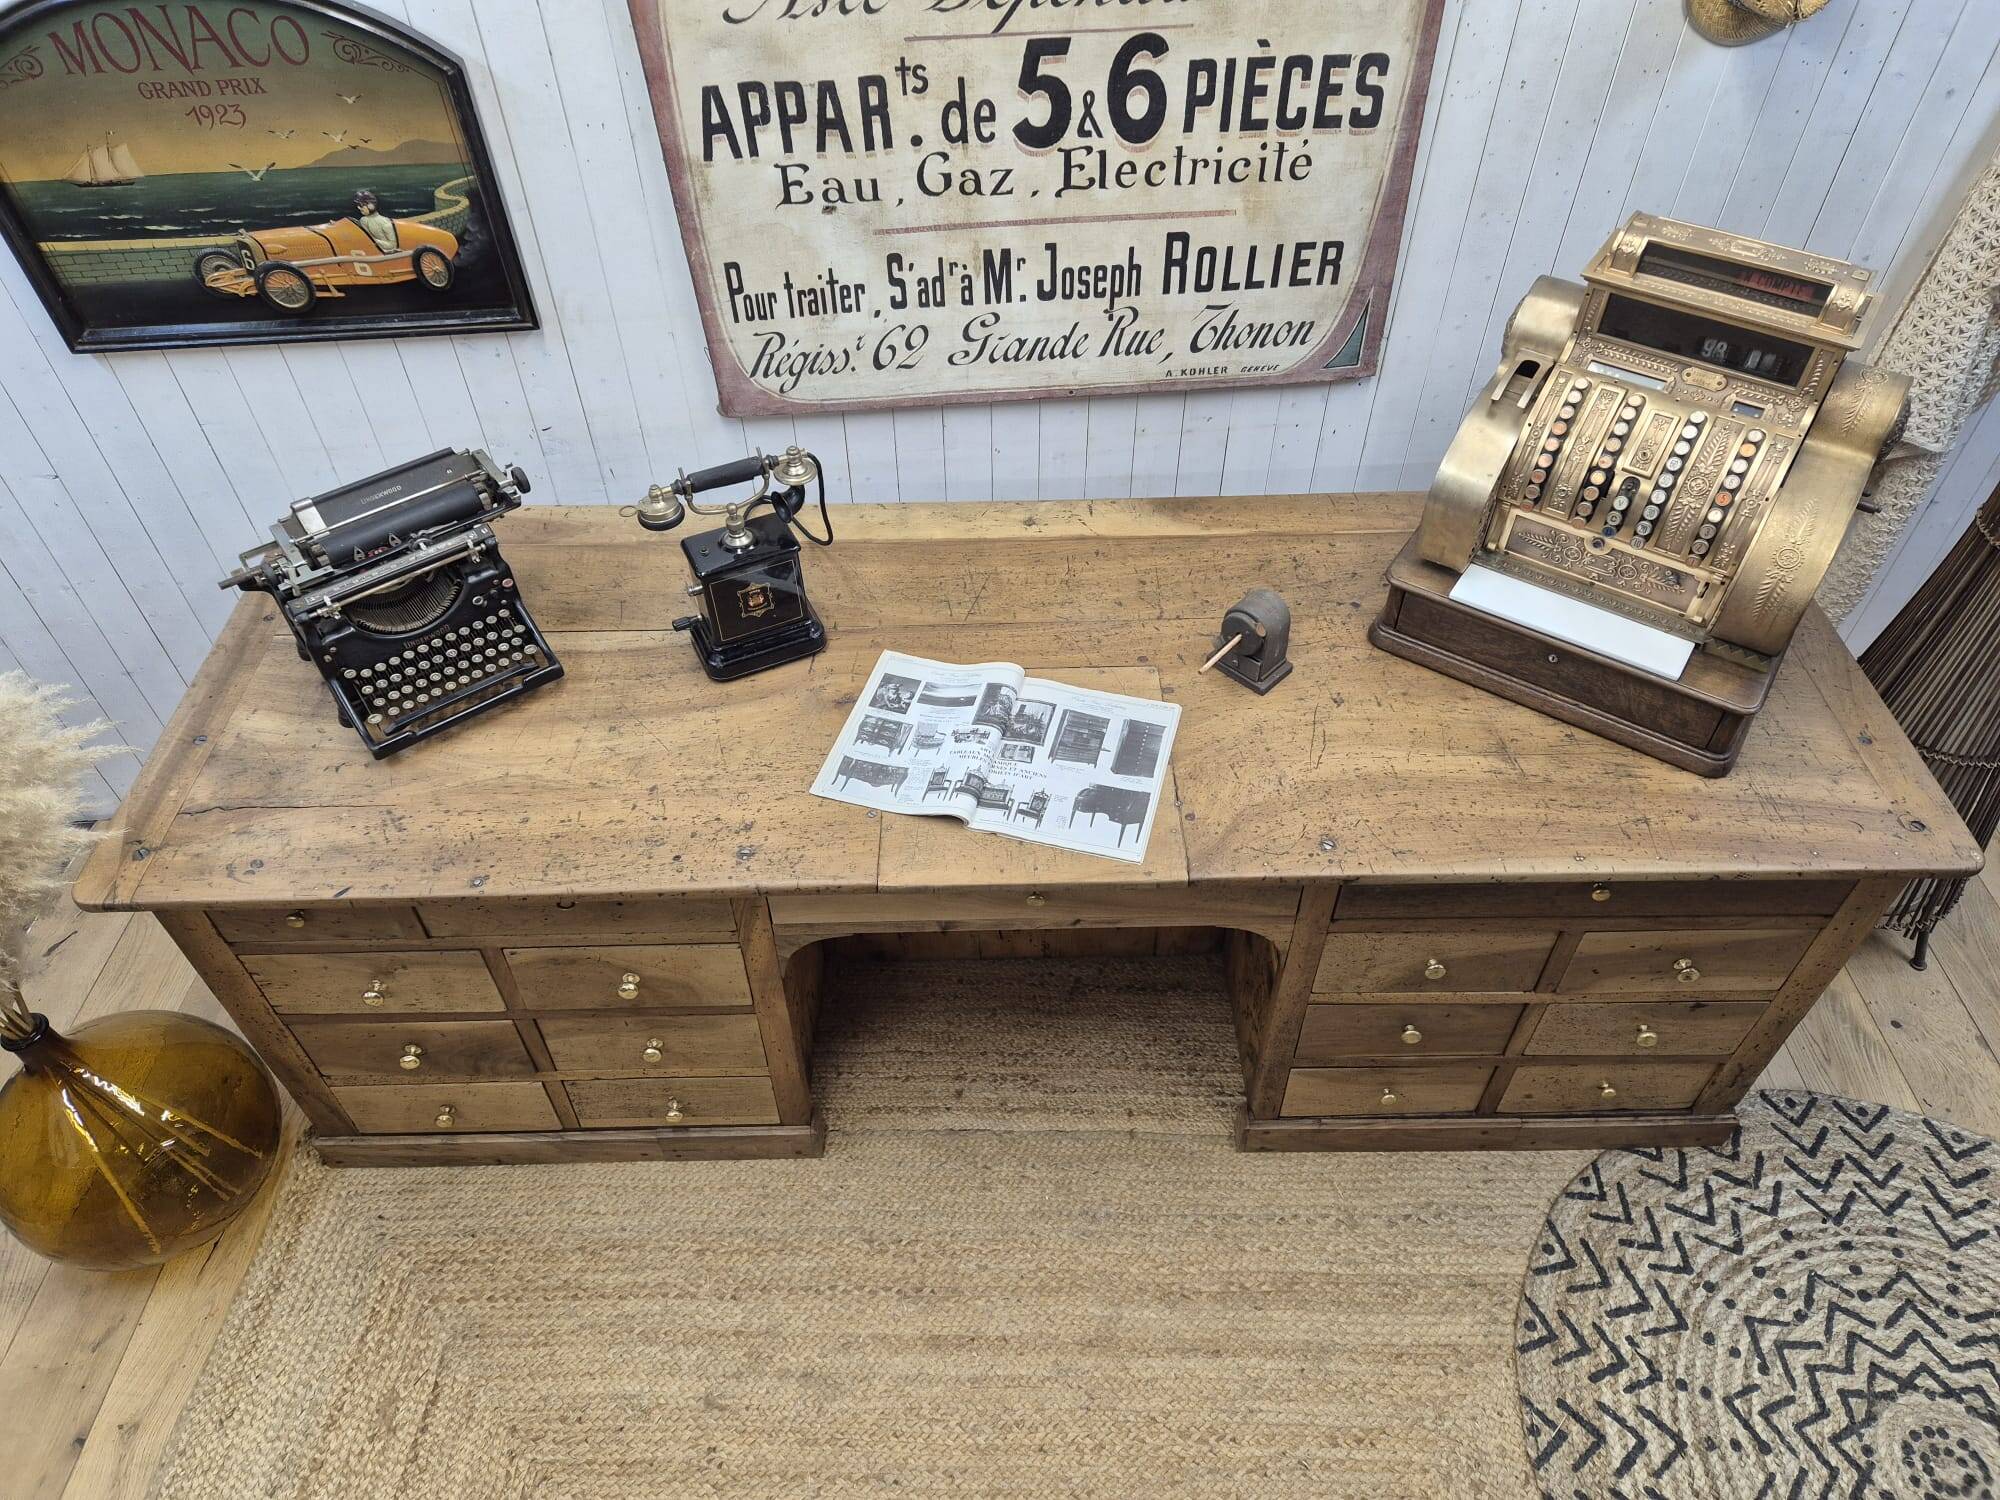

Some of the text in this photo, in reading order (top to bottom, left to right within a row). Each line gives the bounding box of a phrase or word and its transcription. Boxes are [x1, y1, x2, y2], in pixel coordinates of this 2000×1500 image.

[47, 4, 310, 77] MONACO
[137, 77, 268, 100] GRAND PRIX
[184, 103, 247, 129] 1923
[941, 77, 997, 144] de
[1182, 39, 1391, 134] PIÈCES
[1054, 139, 1313, 198] Electricité
[241, 250, 255, 270] 6
[350, 250, 373, 276] 6
[724, 261, 778, 324] Pour
[1037, 242, 1142, 321] Joseph
[1163, 231, 1345, 295] ROLLIER
[947, 312, 1090, 366] Grande
[1188, 301, 1316, 354] Thonon
